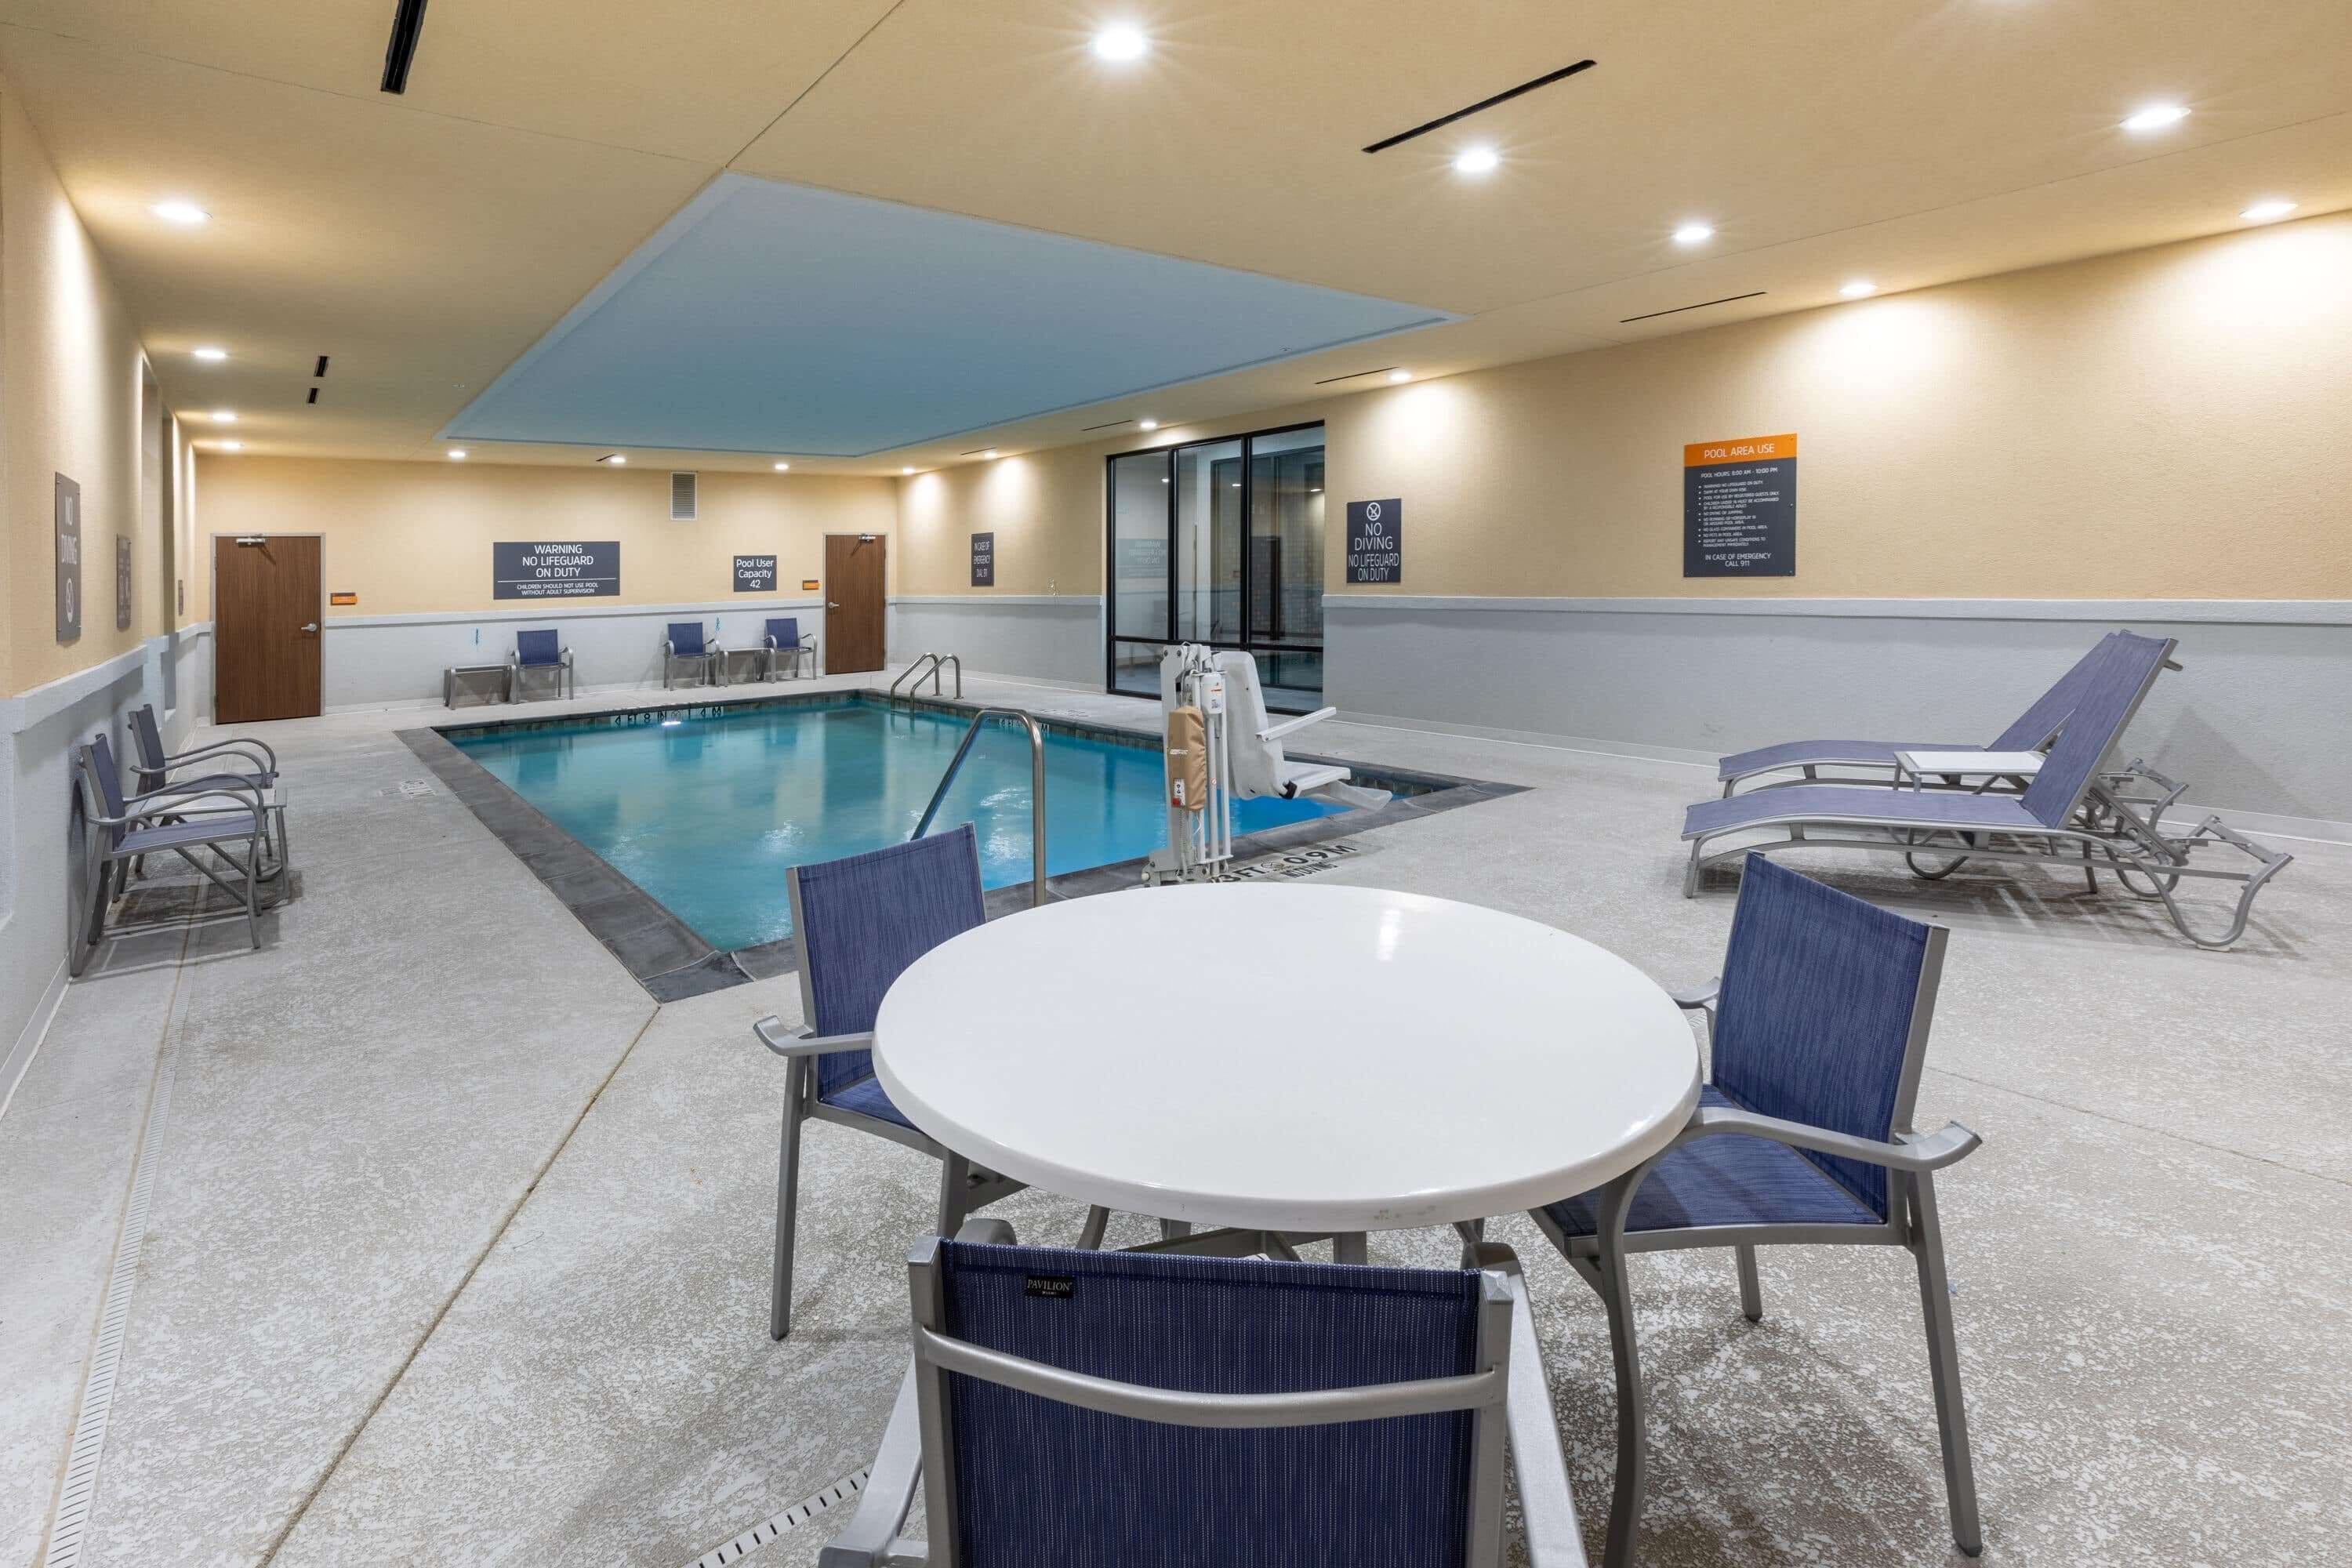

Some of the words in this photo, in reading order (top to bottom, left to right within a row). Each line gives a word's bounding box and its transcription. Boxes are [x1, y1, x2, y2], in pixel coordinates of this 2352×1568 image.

[1704, 449, 1727, 459] POOL
[1730, 446, 1755, 456] AREA
[1757, 443, 1775, 454] USE
[65, 496, 73, 525] NO
[1365, 522, 1382, 536] NO
[535, 544, 583, 554] WARNING
[1355, 536, 1392, 550] DIVING
[522, 557, 538, 566] NO
[540, 555, 594, 566] LIFEGUARD
[736, 559, 754, 568] Pool
[757, 558, 774, 567] User
[1348, 554, 1359, 567] NO
[1360, 553, 1399, 567] LIFEGUARD
[536, 568, 551, 578] ON
[554, 567, 581, 577] DUTY
[738, 569, 772, 579] Capacity
[1357, 568, 1369, 581] ON
[1370, 568, 1389, 581] DUTY
[750, 579, 760, 589] 42
[1027, 1279, 1070, 1292] PAVILION
